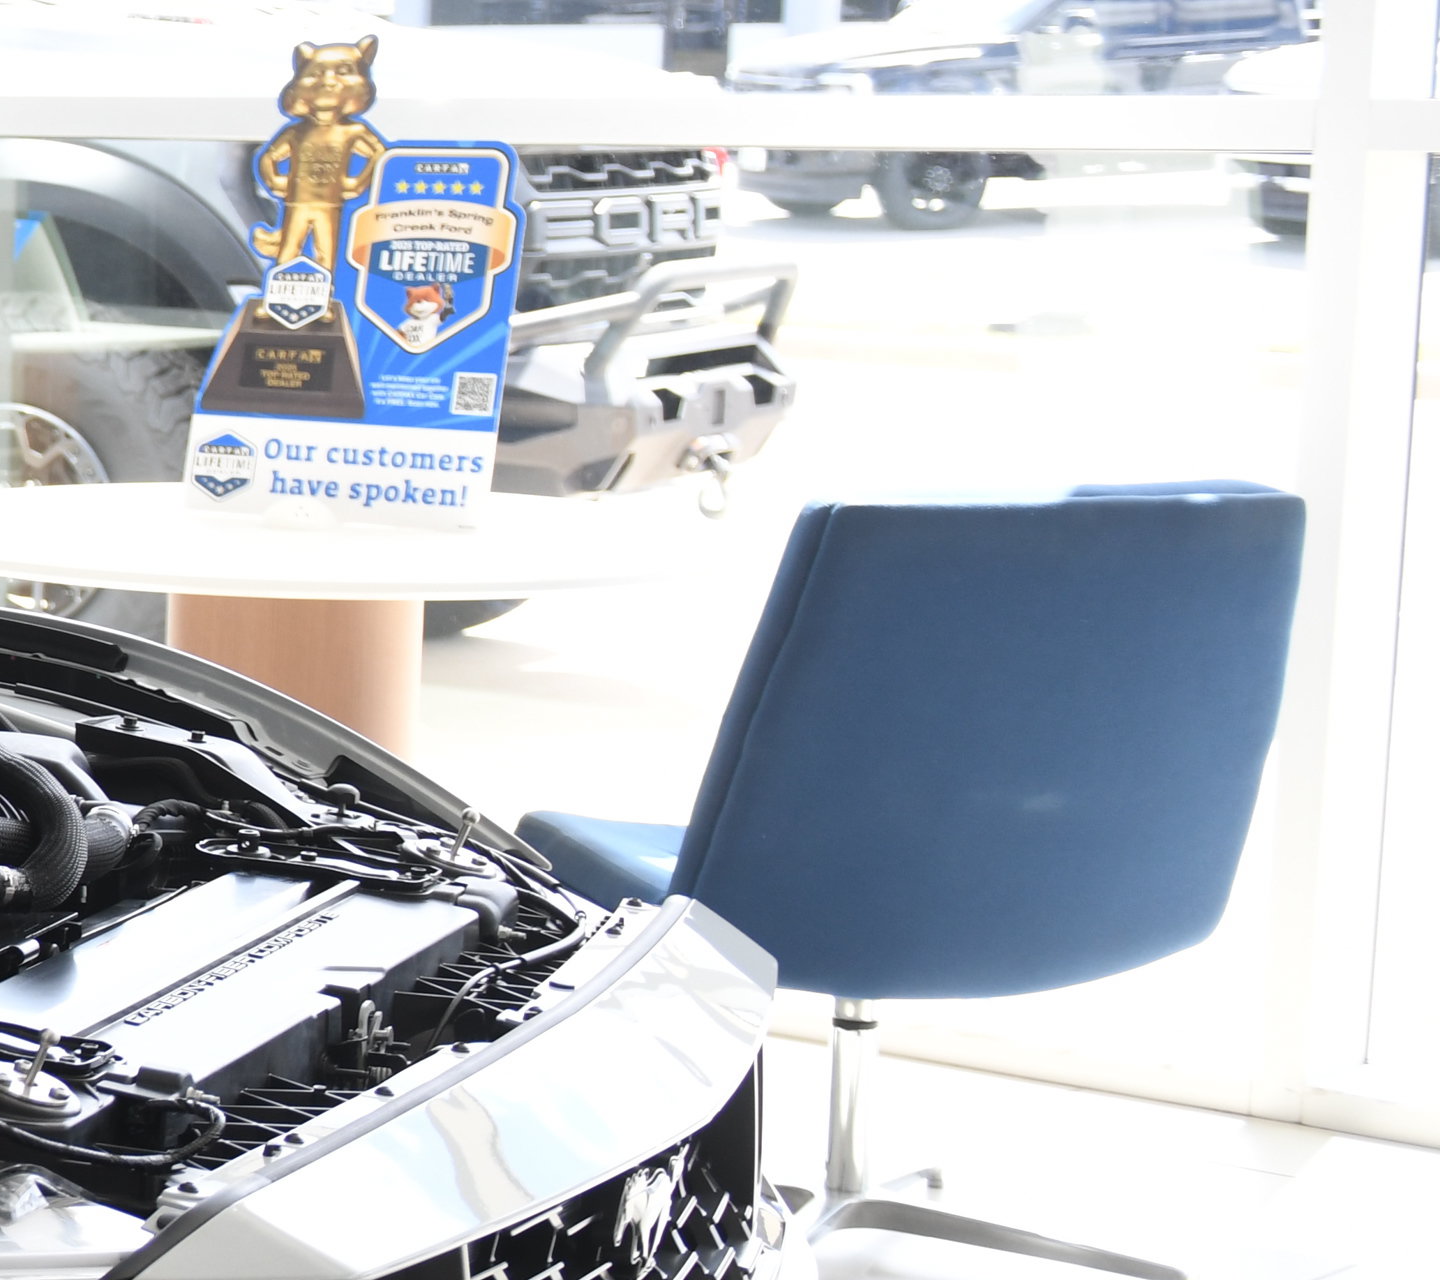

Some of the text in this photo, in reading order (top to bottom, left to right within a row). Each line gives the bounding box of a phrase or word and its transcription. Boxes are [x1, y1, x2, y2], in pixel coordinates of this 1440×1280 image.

[375, 208, 494, 226] Franklin's Spring
[393, 223, 473, 235] Creek Ford
[379, 250, 476, 274] LIFETIME
[392, 271, 458, 283] DEALER
[256, 348, 326, 364] CARFAX
[264, 438, 484, 473] Our customers
[269, 470, 468, 507] have spoken!
